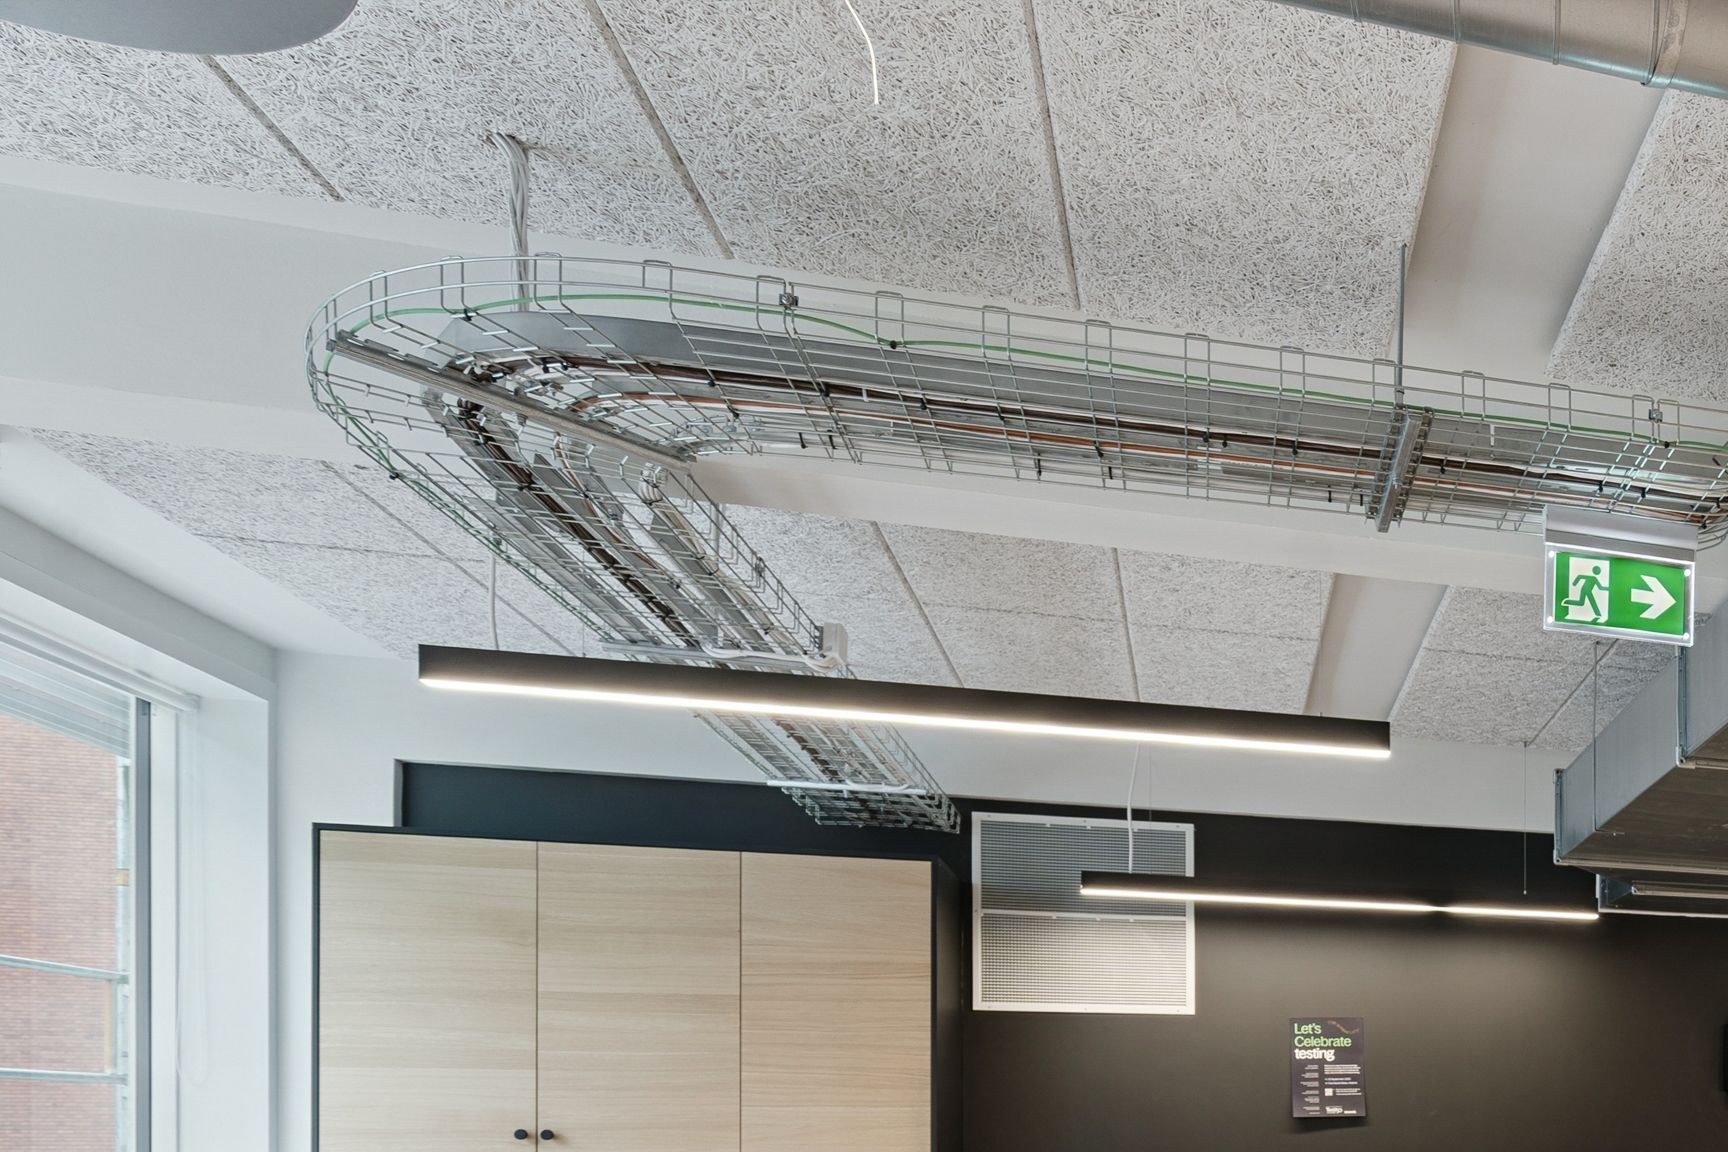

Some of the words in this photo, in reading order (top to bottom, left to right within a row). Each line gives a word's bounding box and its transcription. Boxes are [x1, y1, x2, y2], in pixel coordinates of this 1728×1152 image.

[1294, 1023, 1322, 1034] Let's
[1294, 1036, 1352, 1047] Celebrate
[1294, 1048, 1335, 1061] testing
